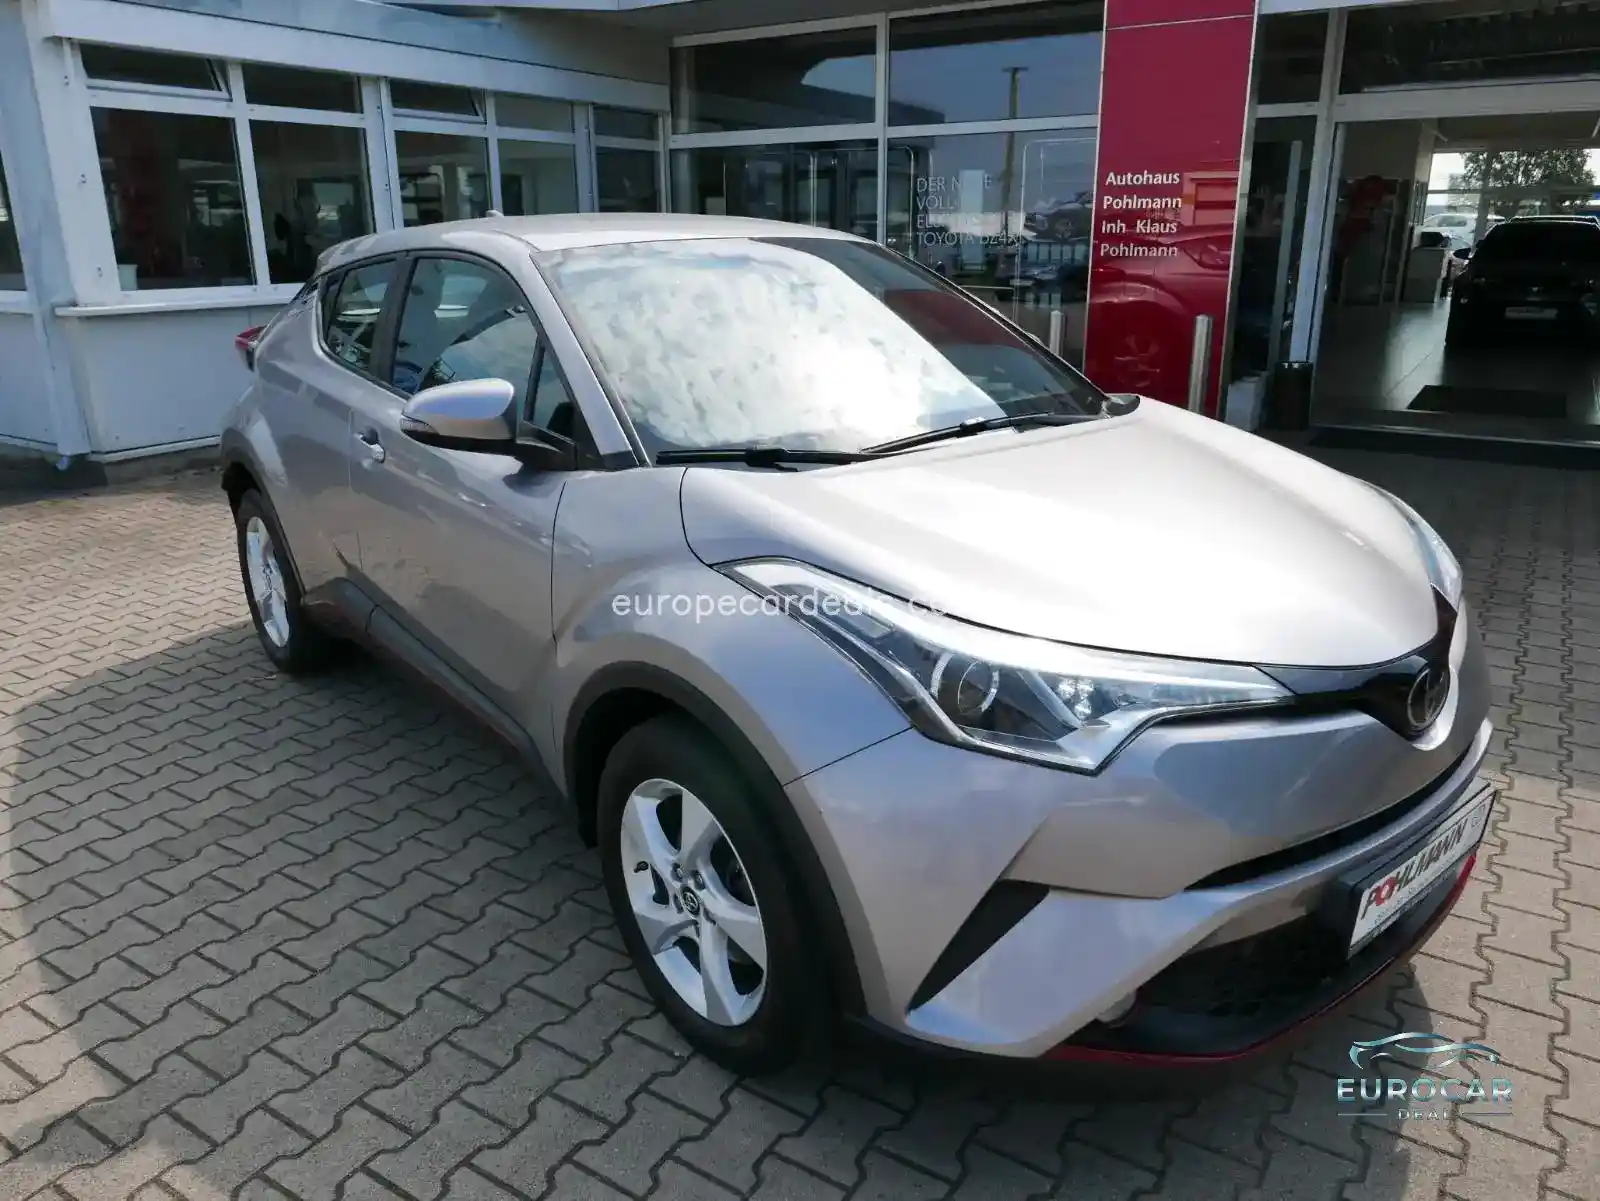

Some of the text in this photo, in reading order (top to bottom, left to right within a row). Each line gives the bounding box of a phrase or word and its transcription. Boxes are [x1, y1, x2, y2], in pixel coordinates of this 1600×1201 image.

[916, 176, 947, 192] DER
[1105, 169, 1180, 186] Autohaus
[1103, 194, 1182, 209] Pohlmann
[1136, 218, 1178, 234] Klaus
[916, 231, 975, 246] TOYOTA
[1100, 242, 1179, 257] Pohlmann
[1360, 817, 1469, 921] POHLMANN
